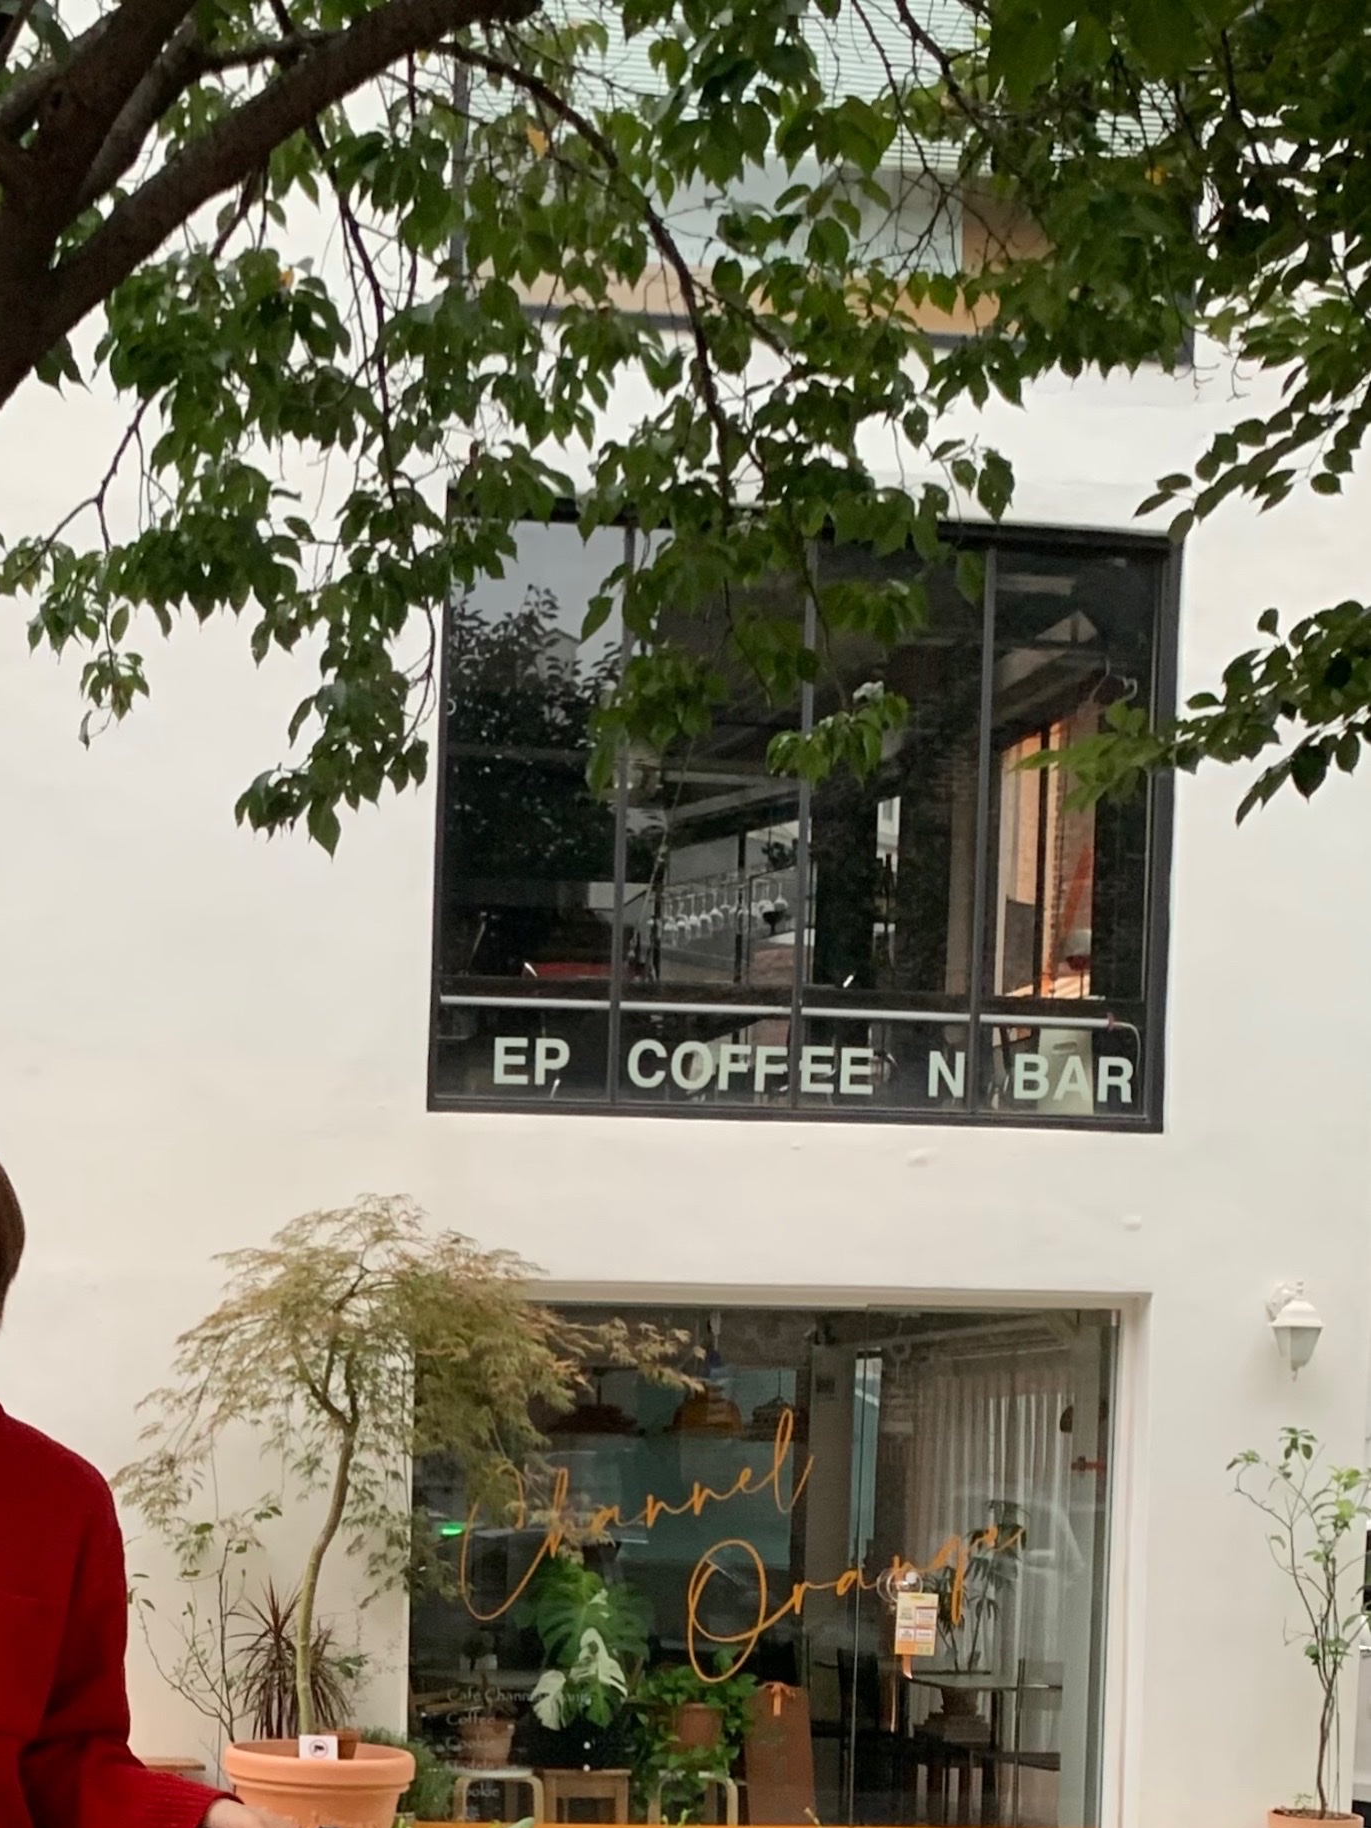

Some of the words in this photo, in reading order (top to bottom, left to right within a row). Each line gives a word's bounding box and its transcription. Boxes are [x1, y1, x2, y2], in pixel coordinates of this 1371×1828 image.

[493, 1036, 570, 1086] EP
[628, 1039, 874, 1096] COFFEE
[928, 1051, 965, 1098] N
[1013, 1053, 1133, 1103] BAR
[460, 1408, 815, 1622] Channel
[687, 1538, 1024, 1684] Orange
